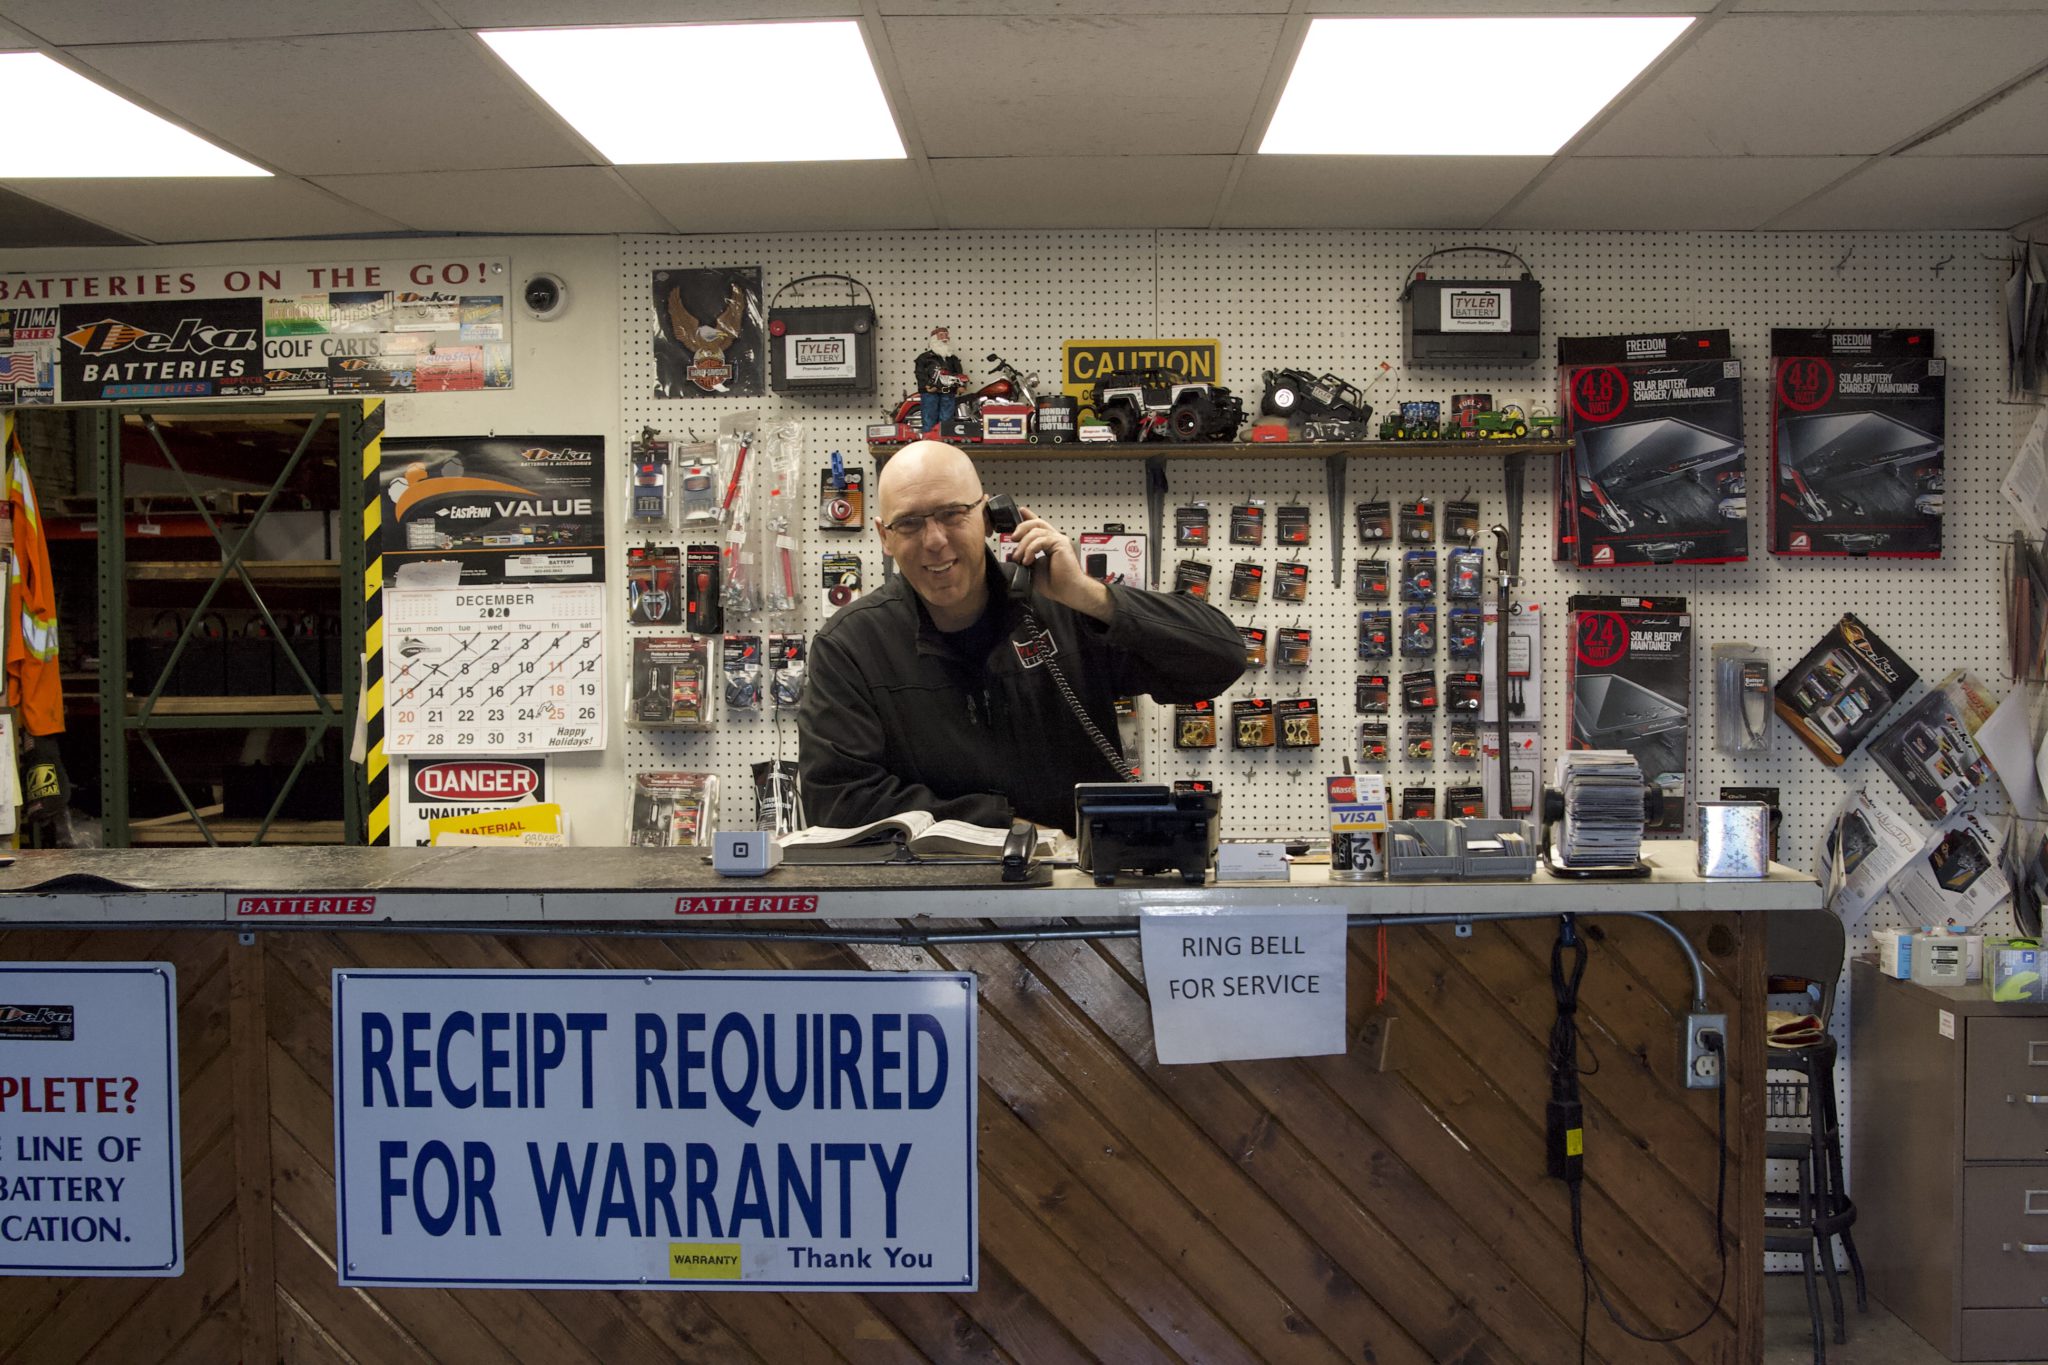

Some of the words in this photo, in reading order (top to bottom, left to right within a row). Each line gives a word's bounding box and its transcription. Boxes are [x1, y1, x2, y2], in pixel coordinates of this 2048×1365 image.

[0, 273, 196, 300] BATTERIES
[224, 269, 281, 291] ON
[307, 267, 381, 289] THE
[409, 263, 487, 285] GO!
[1456, 298, 1495, 307] TYLER
[1456, 308, 1495, 316] BATTERY
[63, 319, 256, 357] Deka
[1626, 339, 1666, 351] FREEDOM
[1832, 334, 1872, 345] FREEDOM
[264, 340, 313, 358] GOLF
[321, 338, 379, 357] CARTS
[800, 344, 839, 354] TYLER
[800, 354, 839, 362] BATTERY
[1073, 351, 1210, 378] CAUTION
[83, 360, 245, 382] BATTERIES
[264, 369, 327, 381] Deka
[1633, 380, 1656, 391] SOLAR
[1658, 378, 1688, 390] BATTERY
[1840, 373, 1862, 384] SOLAR
[1863, 373, 1893, 383] BATTERY
[1583, 372, 1613, 402] 4.8
[1634, 389, 1667, 401] CHARGER
[1672, 386, 1716, 399] MAINTAINER
[522, 448, 592, 461] Deka
[495, 499, 592, 517] VALUE
[456, 594, 534, 606] DECEMBER
[480, 607, 510, 618] 2020
[1584, 618, 1615, 646] 2.4
[1630, 631, 1652, 641] SOLAR
[1654, 631, 1683, 642] BATTERY
[491, 639, 499, 650] 2
[521, 639, 529, 650] 3
[551, 638, 560, 649] 4
[582, 637, 590, 648] 5
[1630, 641, 1671, 651] MAINTAINER
[461, 663, 469, 674] 8
[491, 663, 500, 673] 9
[580, 661, 594, 671] 12
[429, 688, 444, 699] 14
[459, 687, 474, 698] 15
[489, 686, 504, 697] 16
[519, 686, 534, 697] 17
[550, 685, 565, 696] 18
[579, 684, 595, 696] 19
[399, 712, 415, 722] 20
[428, 711, 443, 722] 21
[458, 710, 474, 721] 22
[488, 710, 504, 721] 23
[518, 709, 534, 720] 24
[549, 708, 565, 720] 25
[579, 708, 595, 719] 26
[398, 734, 414, 745] 27
[428, 734, 444, 745] 28
[457, 734, 474, 744] 29
[488, 733, 504, 744] 30
[518, 732, 533, 743] 31
[557, 727, 586, 737] Happy
[549, 737, 593, 746] Holidays!
[424, 769, 530, 792] DANGER
[1339, 812, 1377, 823] VISA
[460, 821, 526, 835] MATERIAL
[240, 898, 374, 914] BATTERIES
[678, 896, 816, 912] BATTERIES
[1182, 936, 1242, 957] RING
[1250, 936, 1306, 955] BELL
[1169, 977, 1216, 1000] FOR
[1223, 974, 1321, 997] SERVICE
[361, 1010, 607, 1109] RECEIPT
[635, 1010, 949, 1128] REQUIRED
[0, 1076, 140, 1114] PLETE?
[17, 1136, 83, 1162] LINE
[97, 1135, 142, 1162] OF
[379, 1139, 502, 1238] FOR
[526, 1141, 913, 1240] WARRANTY
[1, 1215, 132, 1243] CATION.
[674, 1255, 738, 1266] WARRANTY
[787, 1246, 872, 1269] Thank
[883, 1246, 933, 1269] You
